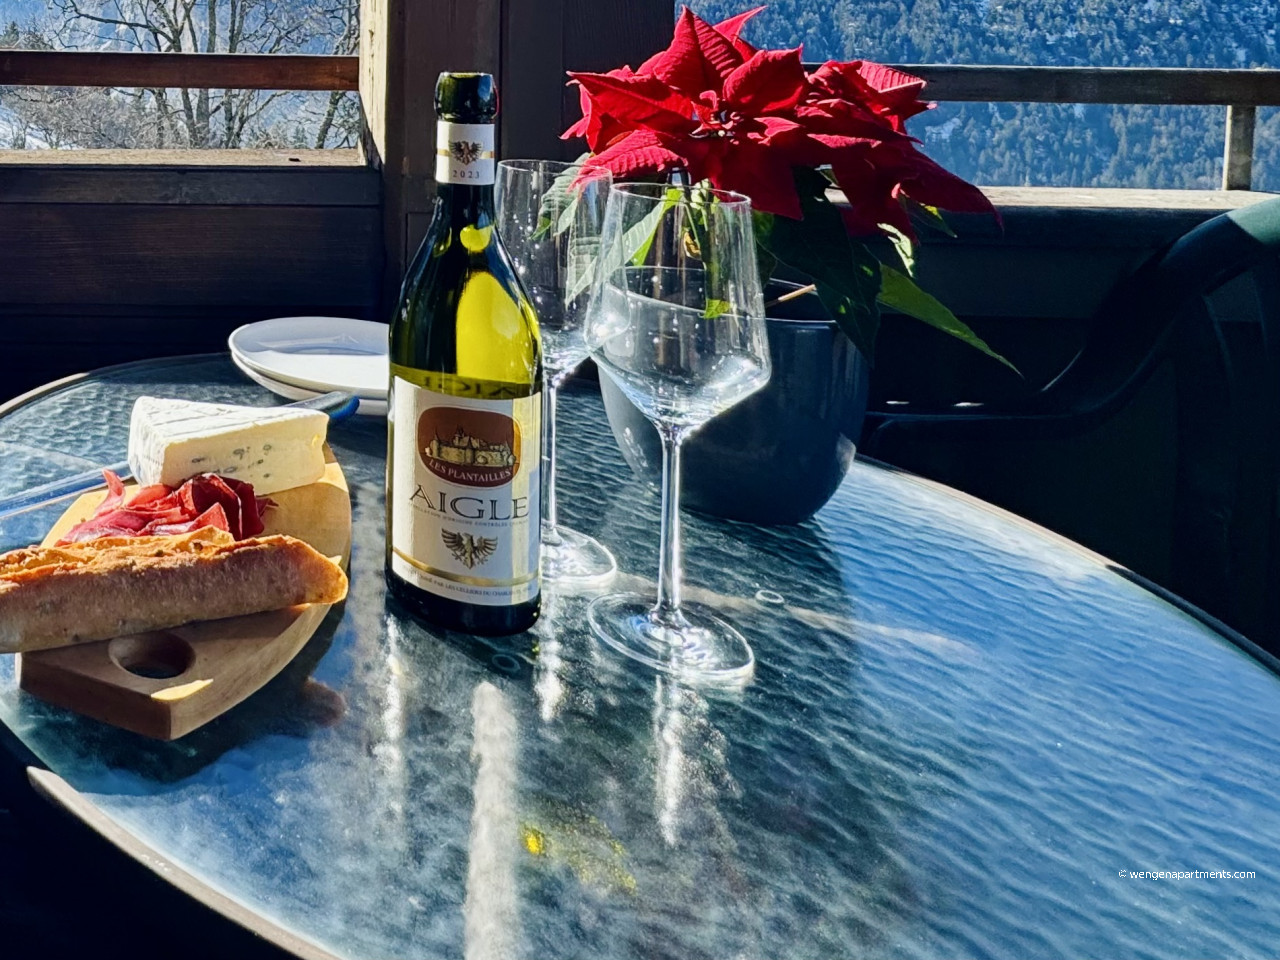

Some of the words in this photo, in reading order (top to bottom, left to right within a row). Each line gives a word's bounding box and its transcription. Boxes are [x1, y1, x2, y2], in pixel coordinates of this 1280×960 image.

[429, 459, 446, 474] LES
[447, 467, 511, 482] PLANTAILLES
[409, 484, 530, 521] AIGLE
